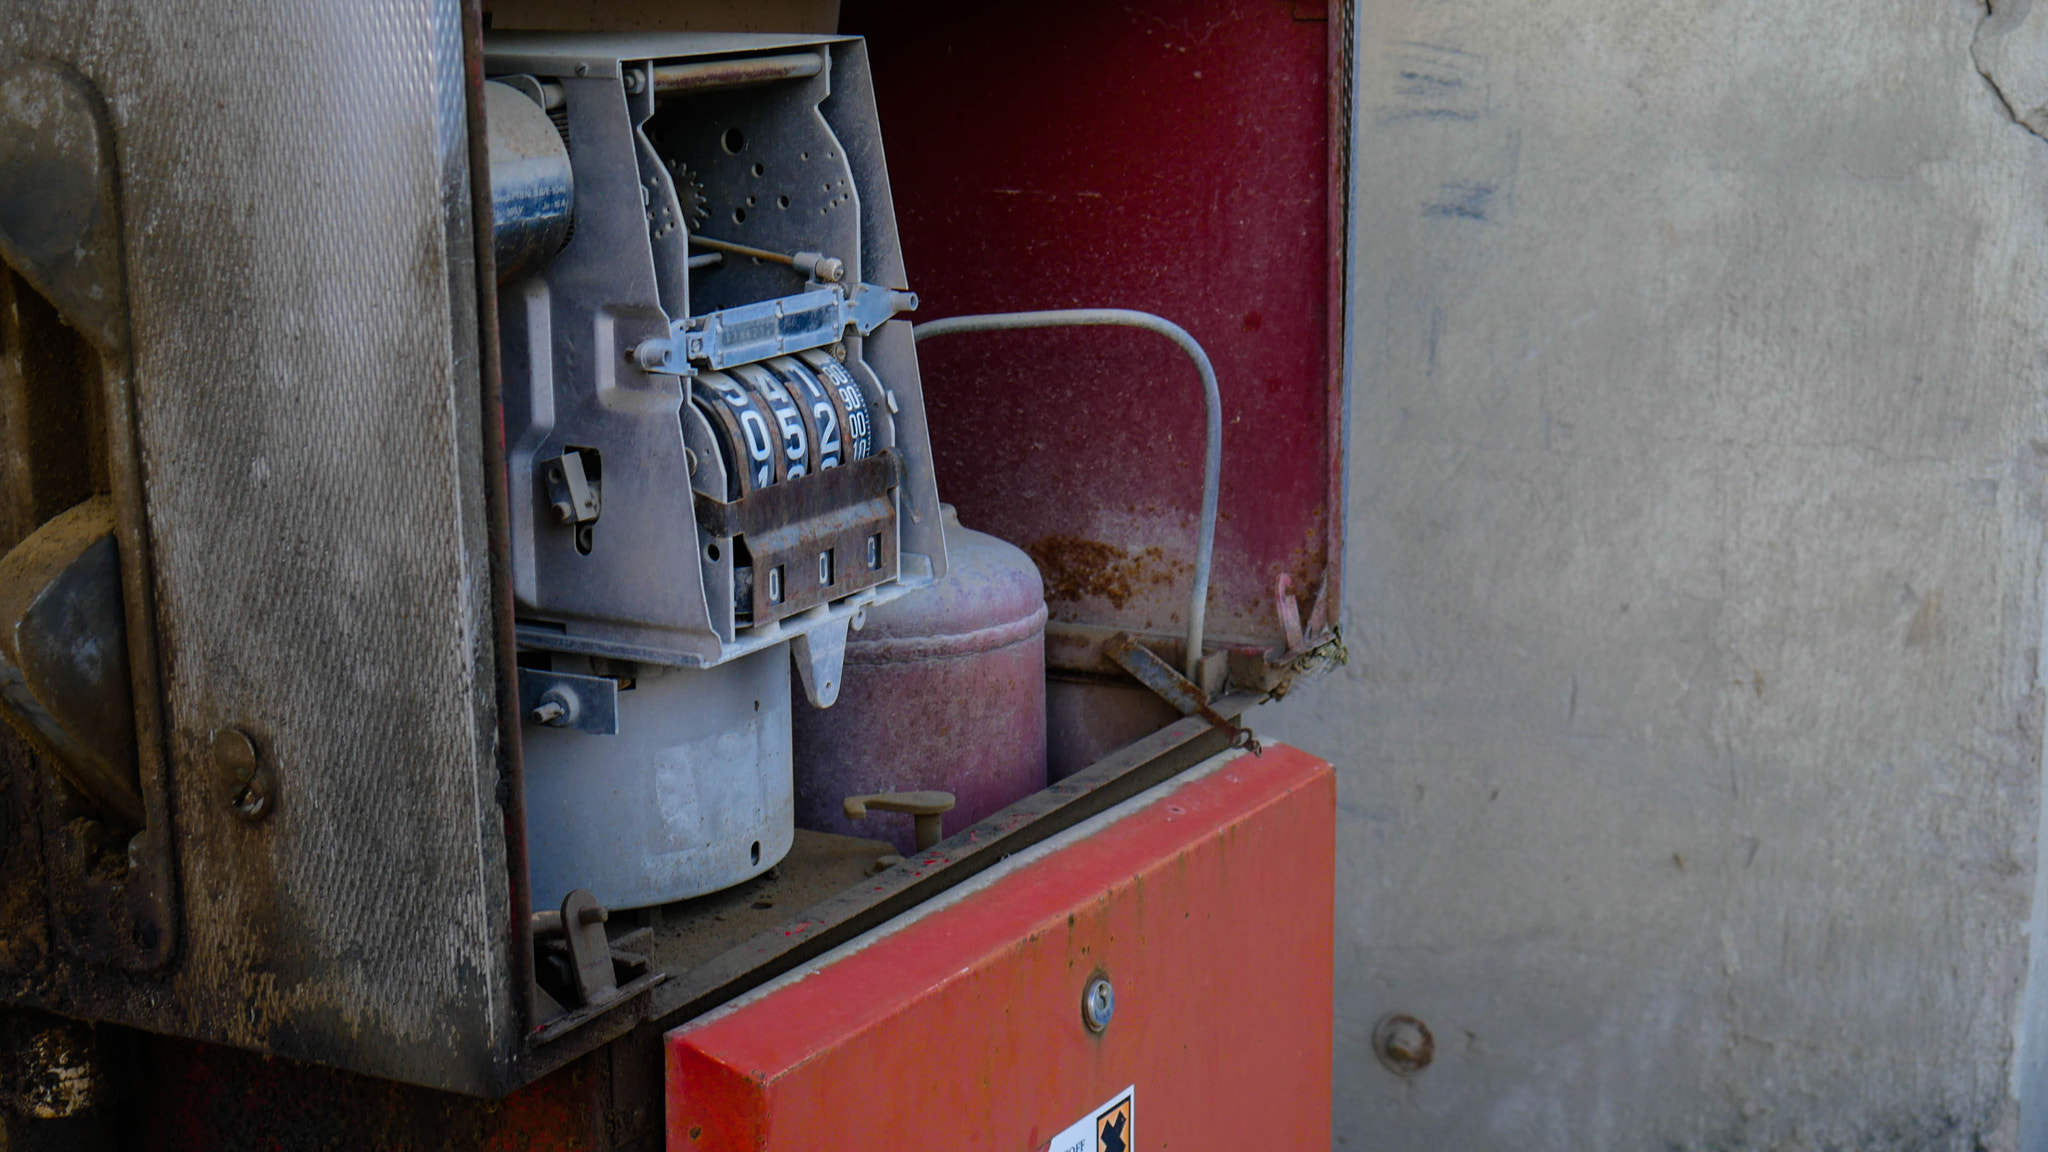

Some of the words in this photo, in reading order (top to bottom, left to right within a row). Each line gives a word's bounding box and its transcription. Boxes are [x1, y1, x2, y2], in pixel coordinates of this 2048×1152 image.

[839, 385, 860, 411] 90
[741, 410, 771, 461] 0
[776, 407, 806, 460] 5
[814, 402, 839, 454] 2
[848, 408, 866, 439] 00
[769, 567, 779, 601] 0
[820, 551, 828, 584] 0
[867, 536, 876, 568] 0
[1064, 1139, 1086, 1152] OFF
